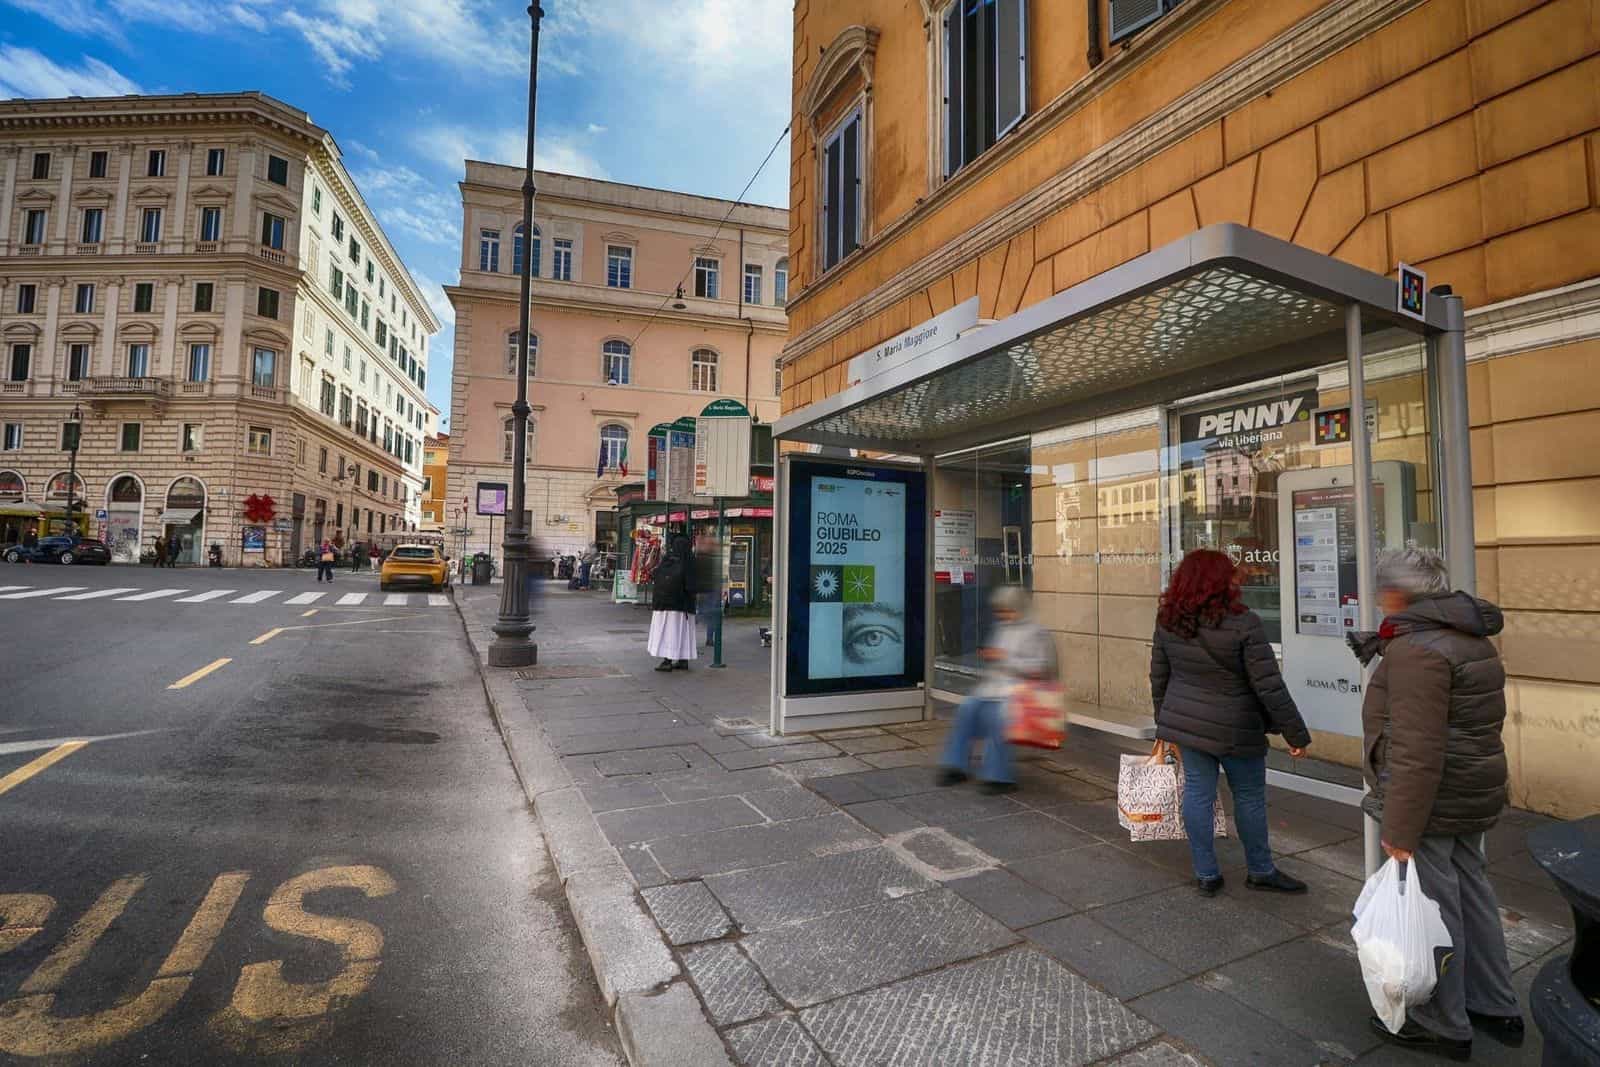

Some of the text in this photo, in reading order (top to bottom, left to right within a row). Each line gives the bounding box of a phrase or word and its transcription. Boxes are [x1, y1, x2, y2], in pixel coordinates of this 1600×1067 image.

[883, 340, 902, 358] Maria
[903, 325, 938, 349] Maggiore
[1218, 430, 1283, 448] via Liberiana
[817, 511, 858, 526] ROMA
[816, 527, 881, 542] GIUBILEO
[816, 541, 848, 555] 2025
[1306, 679, 1337, 690] ROMA
